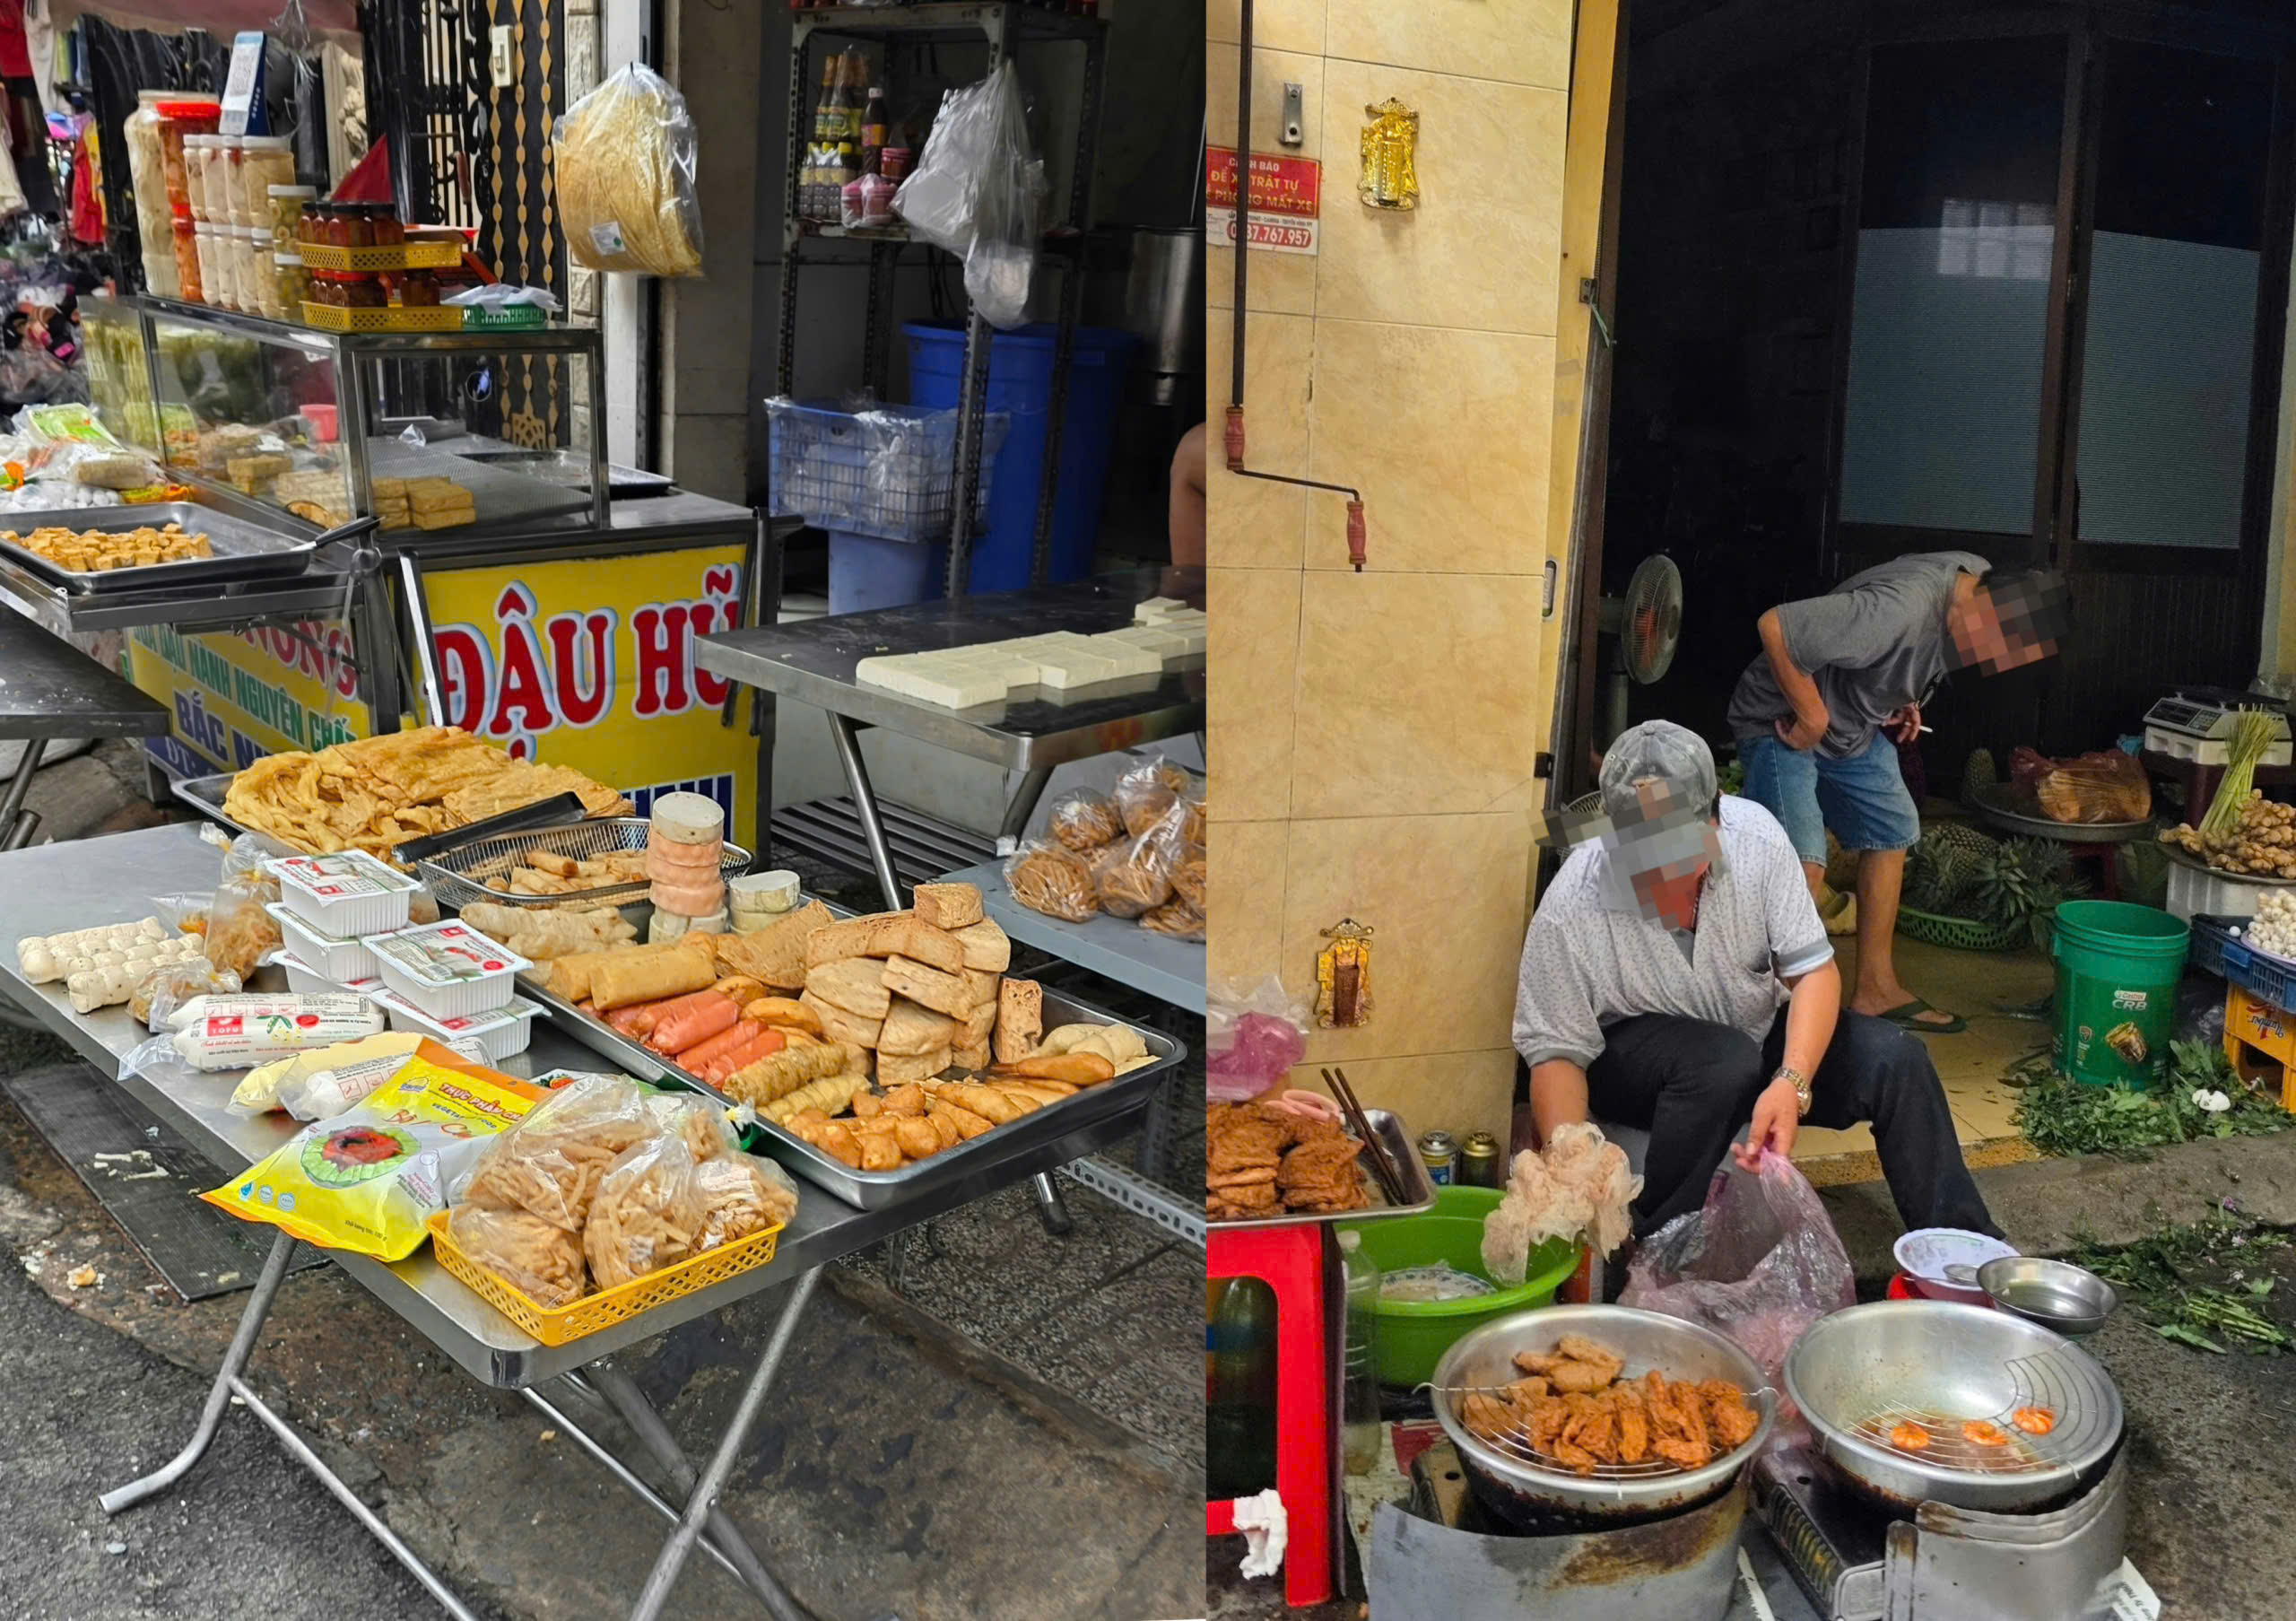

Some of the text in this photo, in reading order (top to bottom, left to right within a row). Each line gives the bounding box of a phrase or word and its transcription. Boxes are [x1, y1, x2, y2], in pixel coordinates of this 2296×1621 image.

[1250, 174, 1281, 192] TRẬT
[1297, 198, 1314, 212] XE
[1230, 222, 1310, 247] 037.767.957
[424, 580, 618, 762] ĐẬU
[234, 666, 307, 747] NGUYÊN
[174, 690, 230, 763] BẮC
[211, 1025, 240, 1035] TOFU
